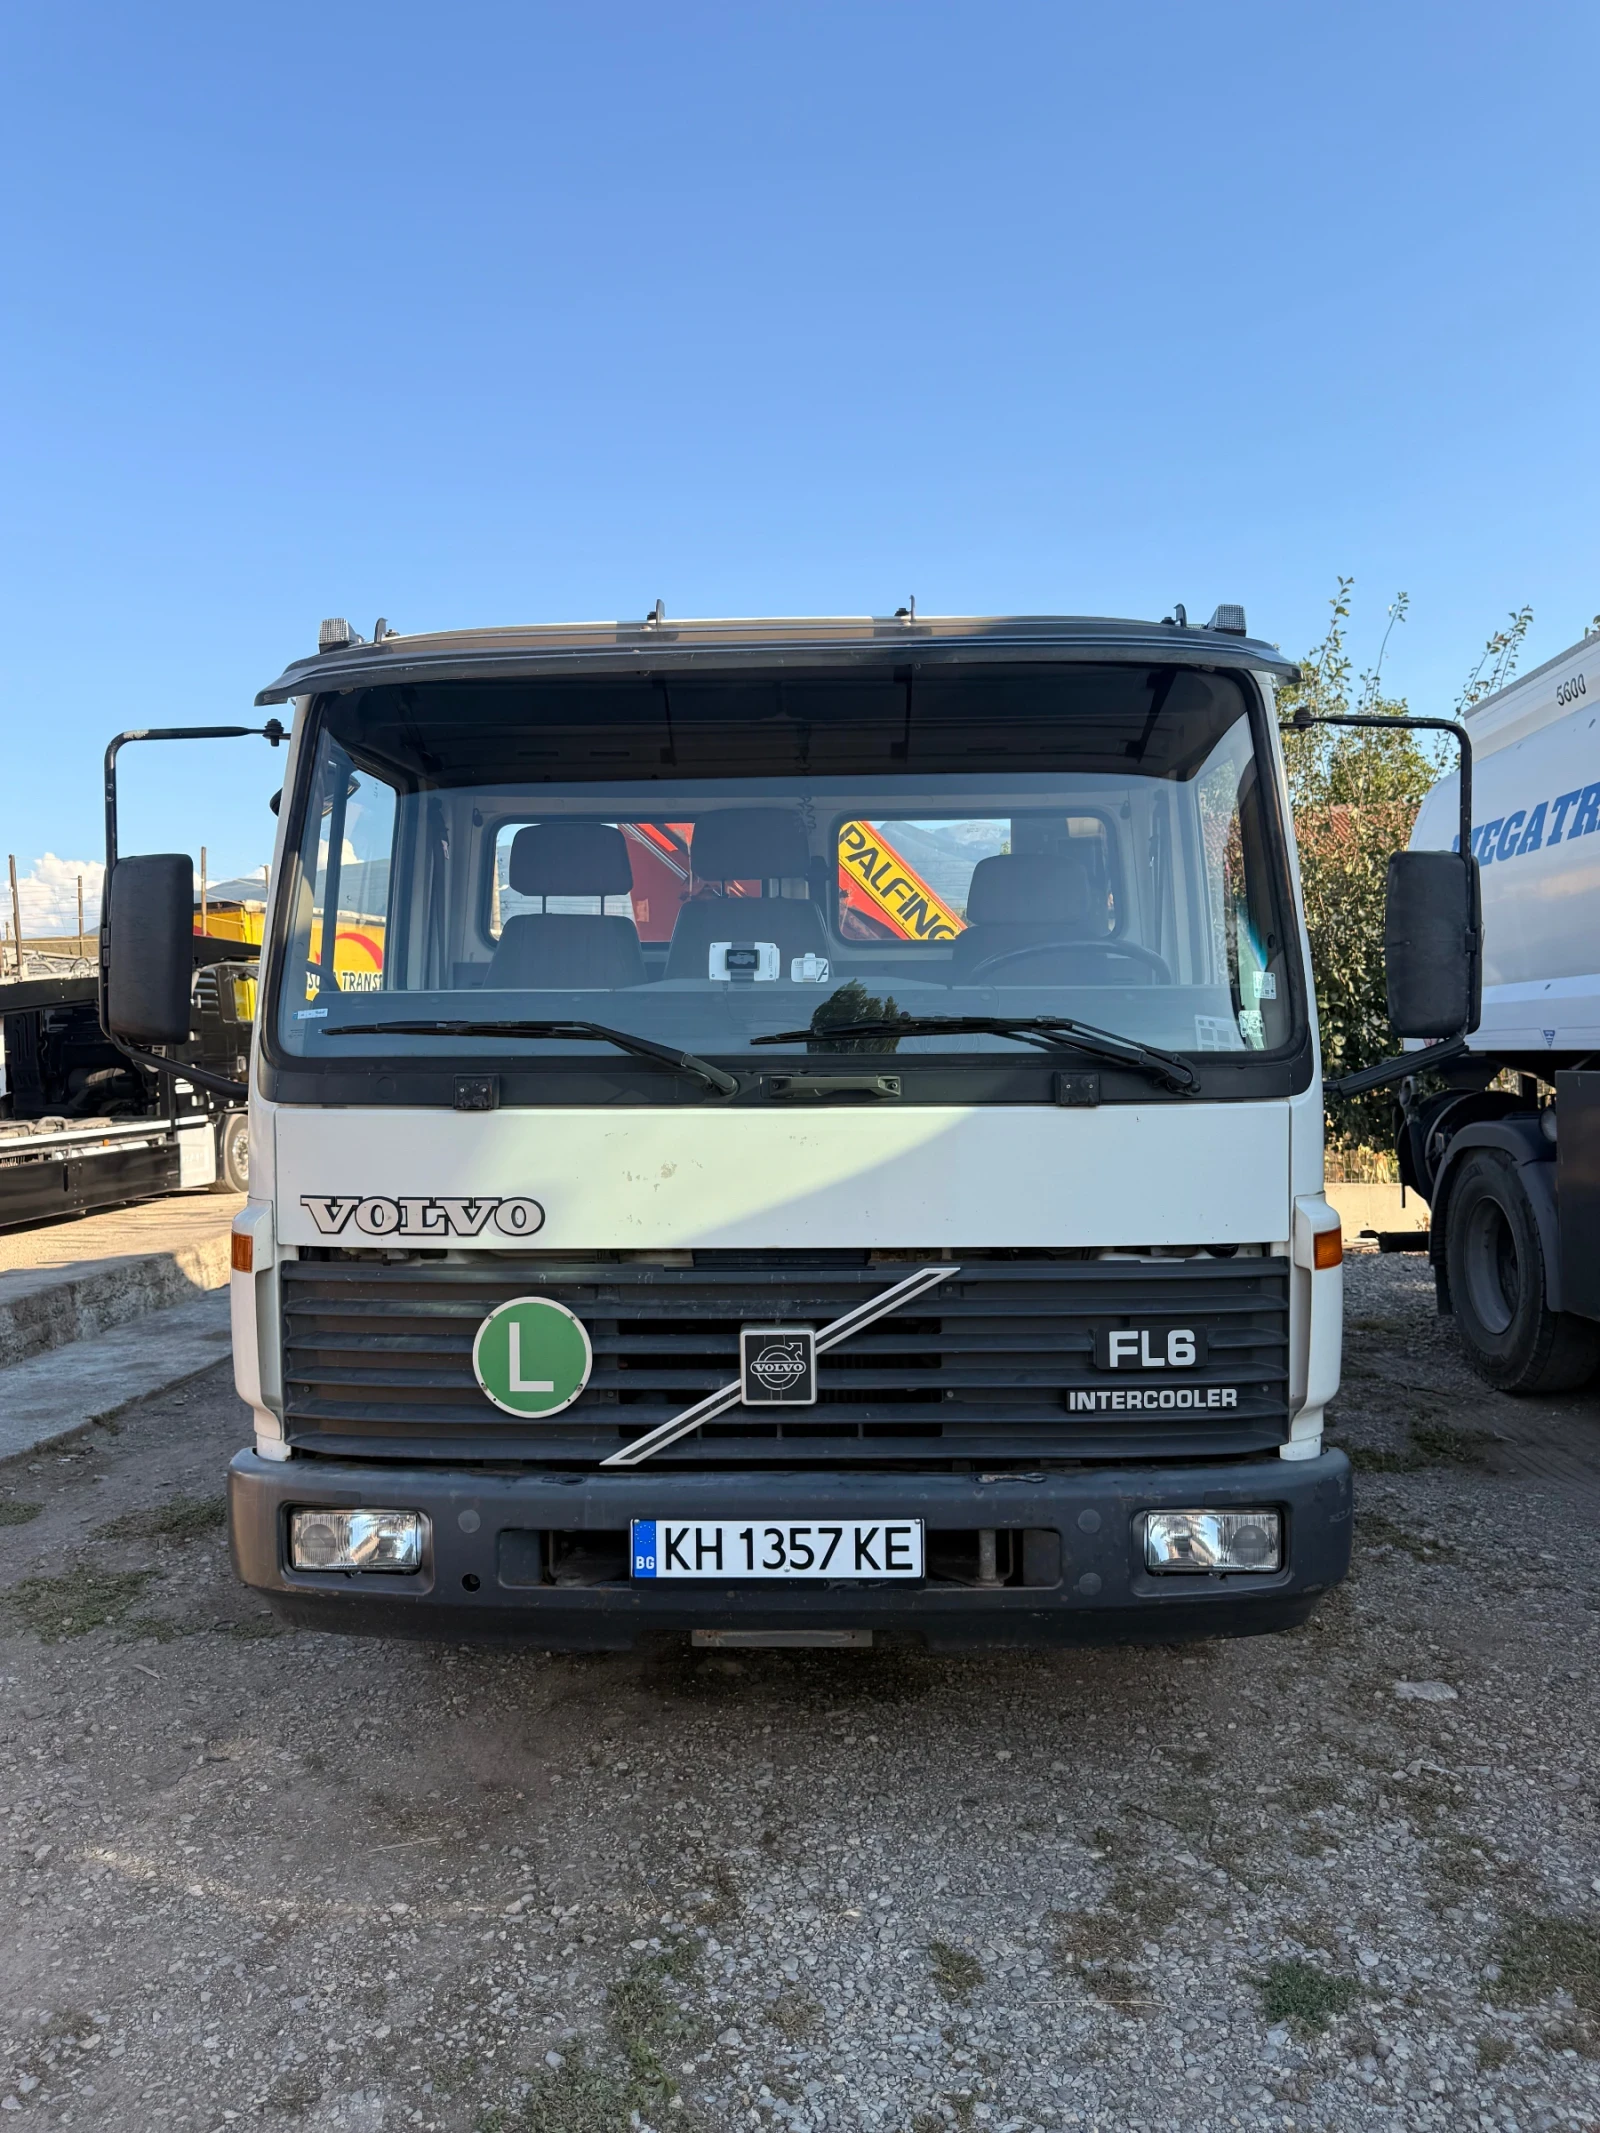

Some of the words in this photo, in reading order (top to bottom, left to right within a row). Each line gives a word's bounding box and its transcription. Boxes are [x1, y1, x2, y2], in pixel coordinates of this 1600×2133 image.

[1556, 673, 1587, 707] 5600
[300, 1195, 546, 1238] VOLVO
[508, 1321, 555, 1393] L
[1108, 1329, 1197, 1368] FL6
[753, 1363, 804, 1372] VOLVO
[1069, 1388, 1238, 1411] INTERCOOLER
[635, 1556, 655, 1570] BG
[665, 1527, 723, 1571] KH
[739, 1527, 843, 1571] 1357
[854, 1526, 914, 1571] KE
